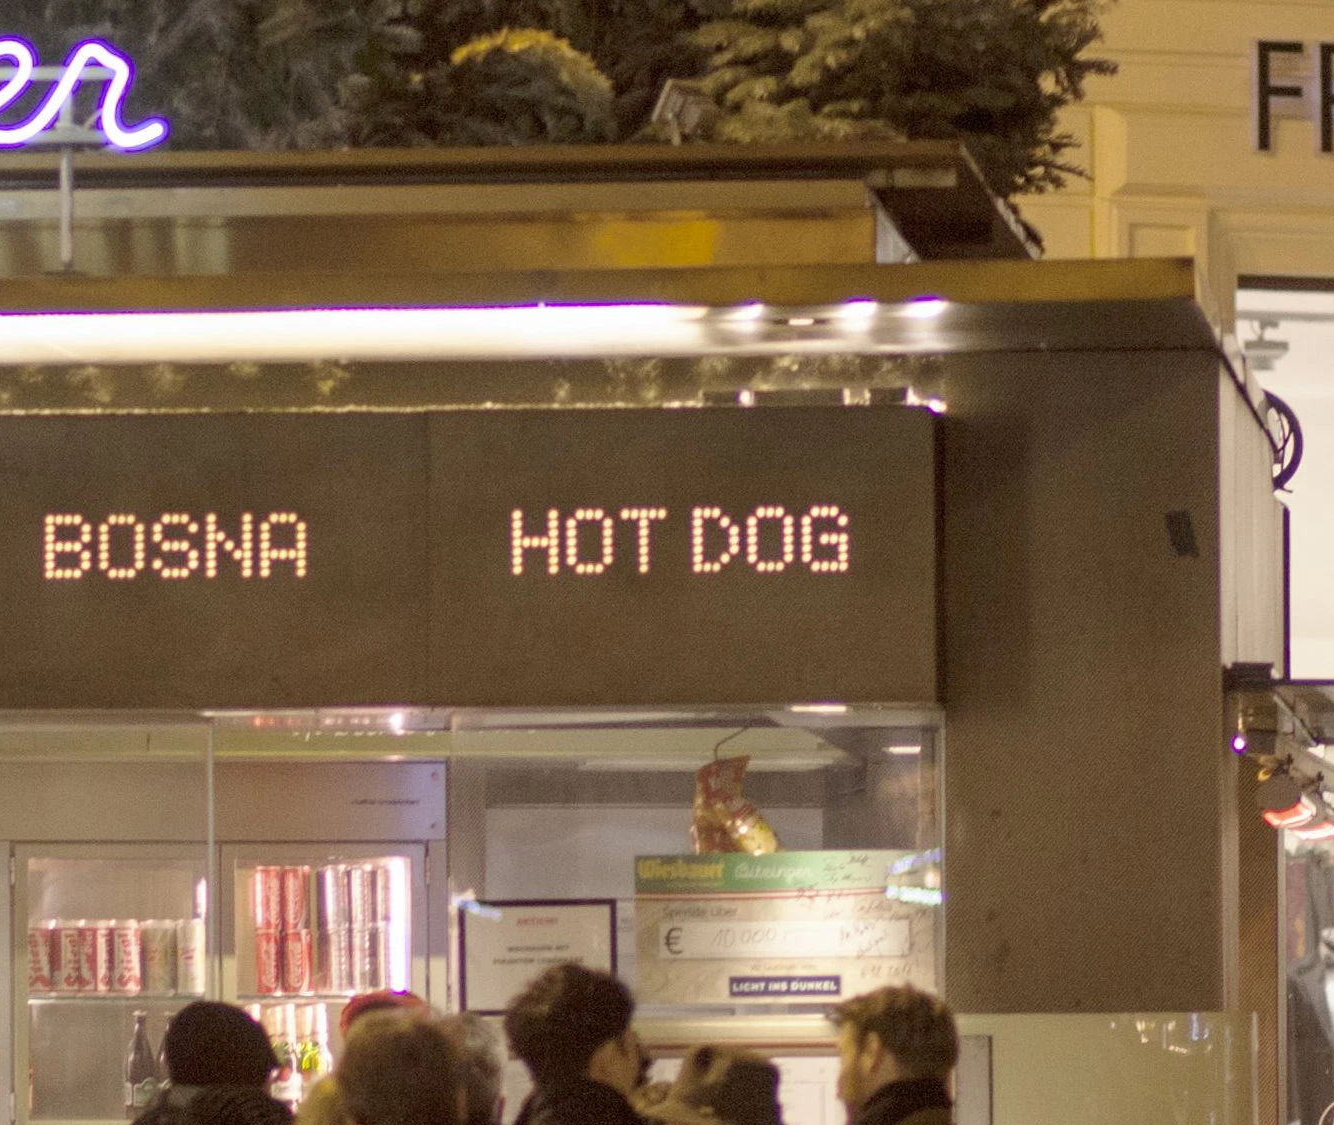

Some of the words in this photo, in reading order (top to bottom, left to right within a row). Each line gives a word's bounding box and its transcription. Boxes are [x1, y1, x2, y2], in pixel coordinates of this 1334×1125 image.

[42, 511, 308, 580] BOSNA
[510, 507, 668, 577] HOT
[691, 504, 851, 575] DOG
